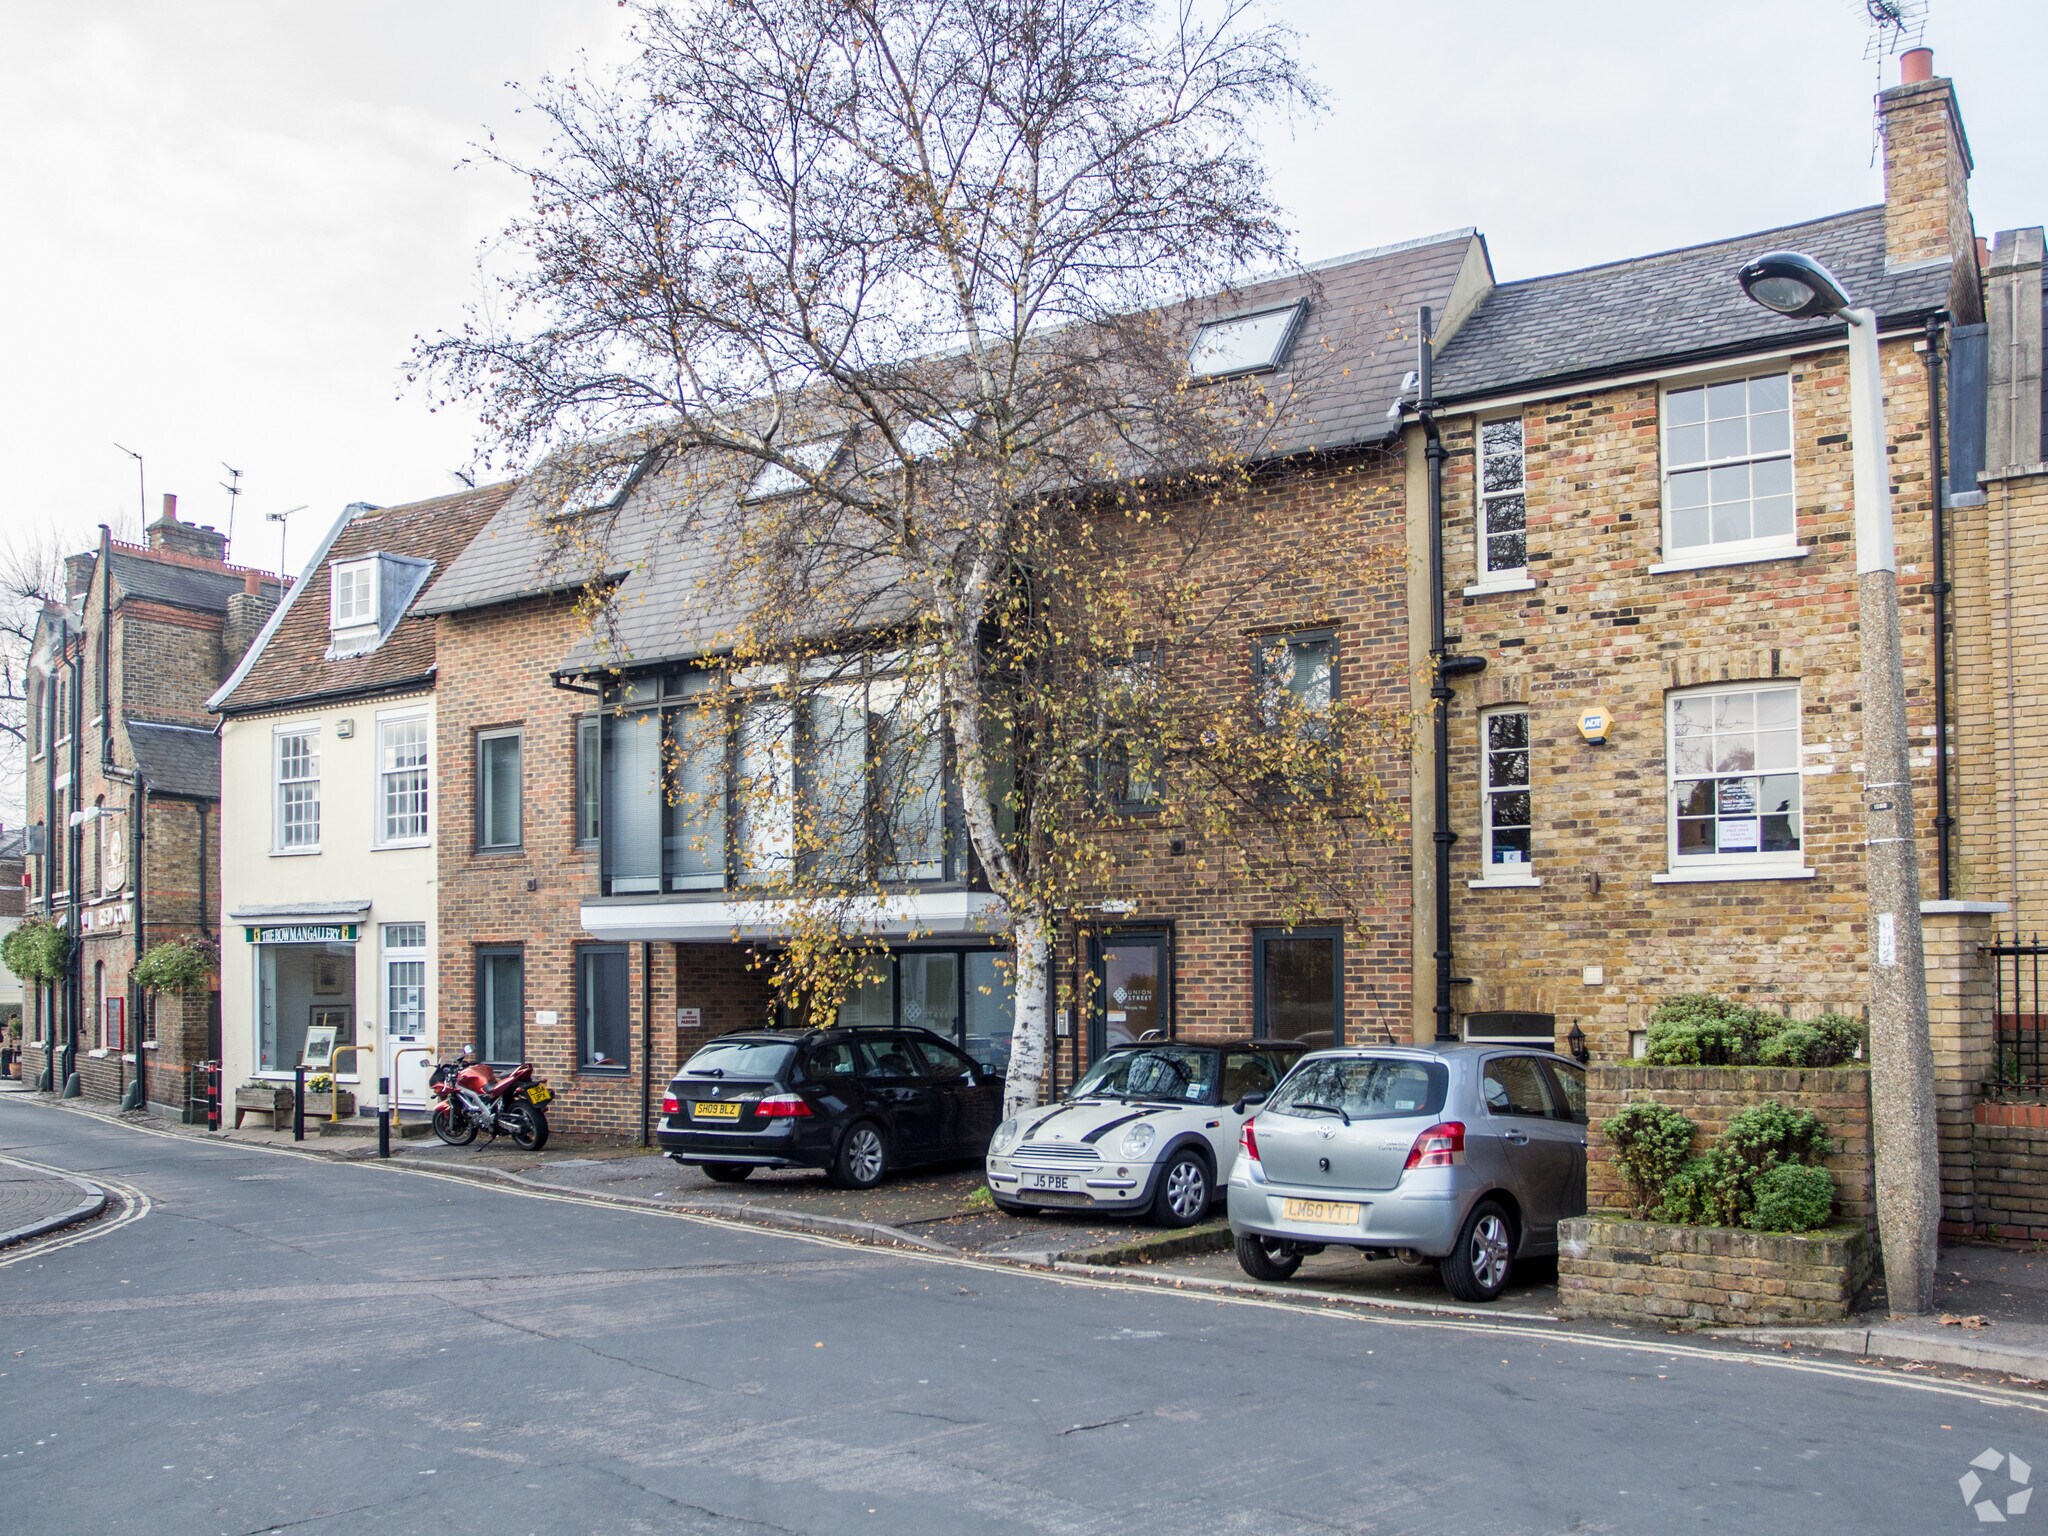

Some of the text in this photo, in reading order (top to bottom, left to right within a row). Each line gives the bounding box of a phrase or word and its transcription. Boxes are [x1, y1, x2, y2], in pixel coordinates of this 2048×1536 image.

[1584, 718, 1601, 728] ADT
[262, 926, 340, 942] THE BOWMAN GALLERY
[698, 1104, 736, 1114] SH09 BLZ
[1034, 1175, 1069, 1189] J5 PBE
[1288, 1202, 1354, 1219] LM60 VTT
